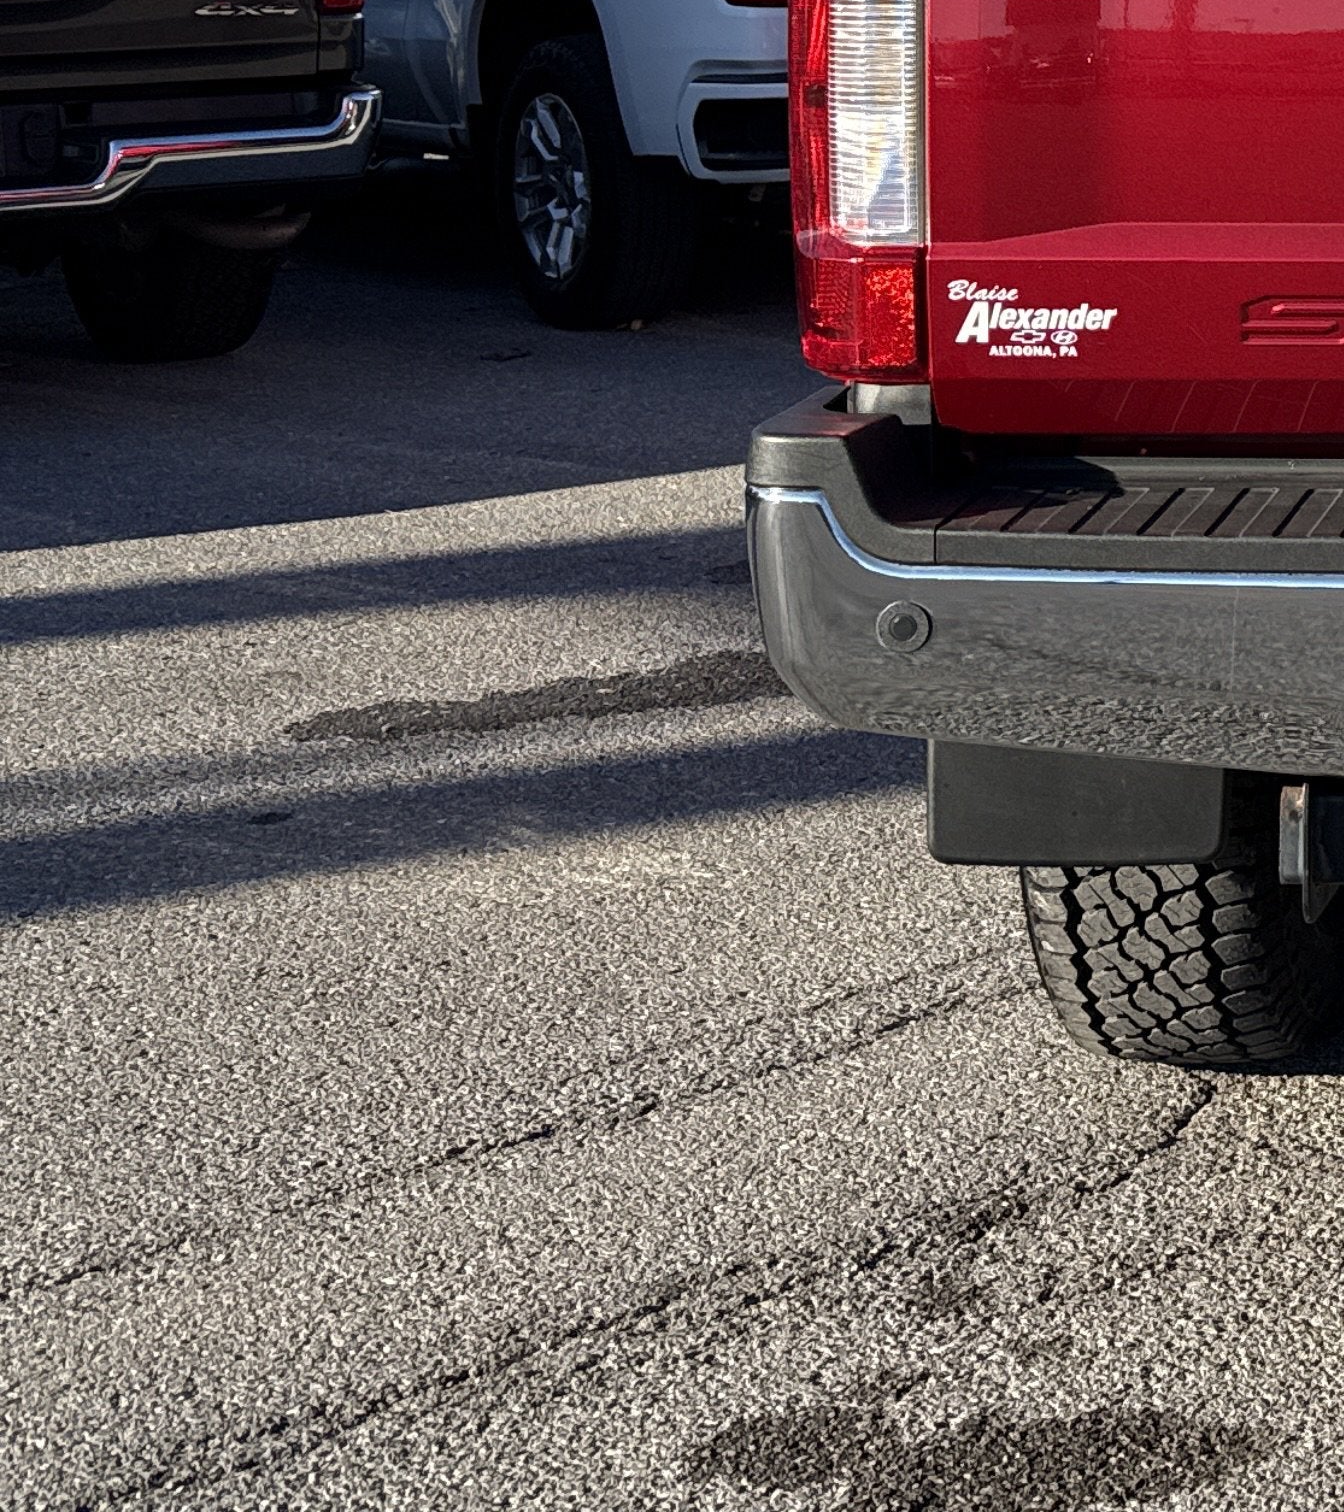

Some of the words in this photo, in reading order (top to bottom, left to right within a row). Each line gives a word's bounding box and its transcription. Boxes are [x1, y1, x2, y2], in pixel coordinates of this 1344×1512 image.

[947, 279, 1019, 301] Blaise
[955, 301, 1118, 343] Alexander
[989, 346, 1057, 358] ALTOONA,
[1059, 346, 1078, 357] PA
